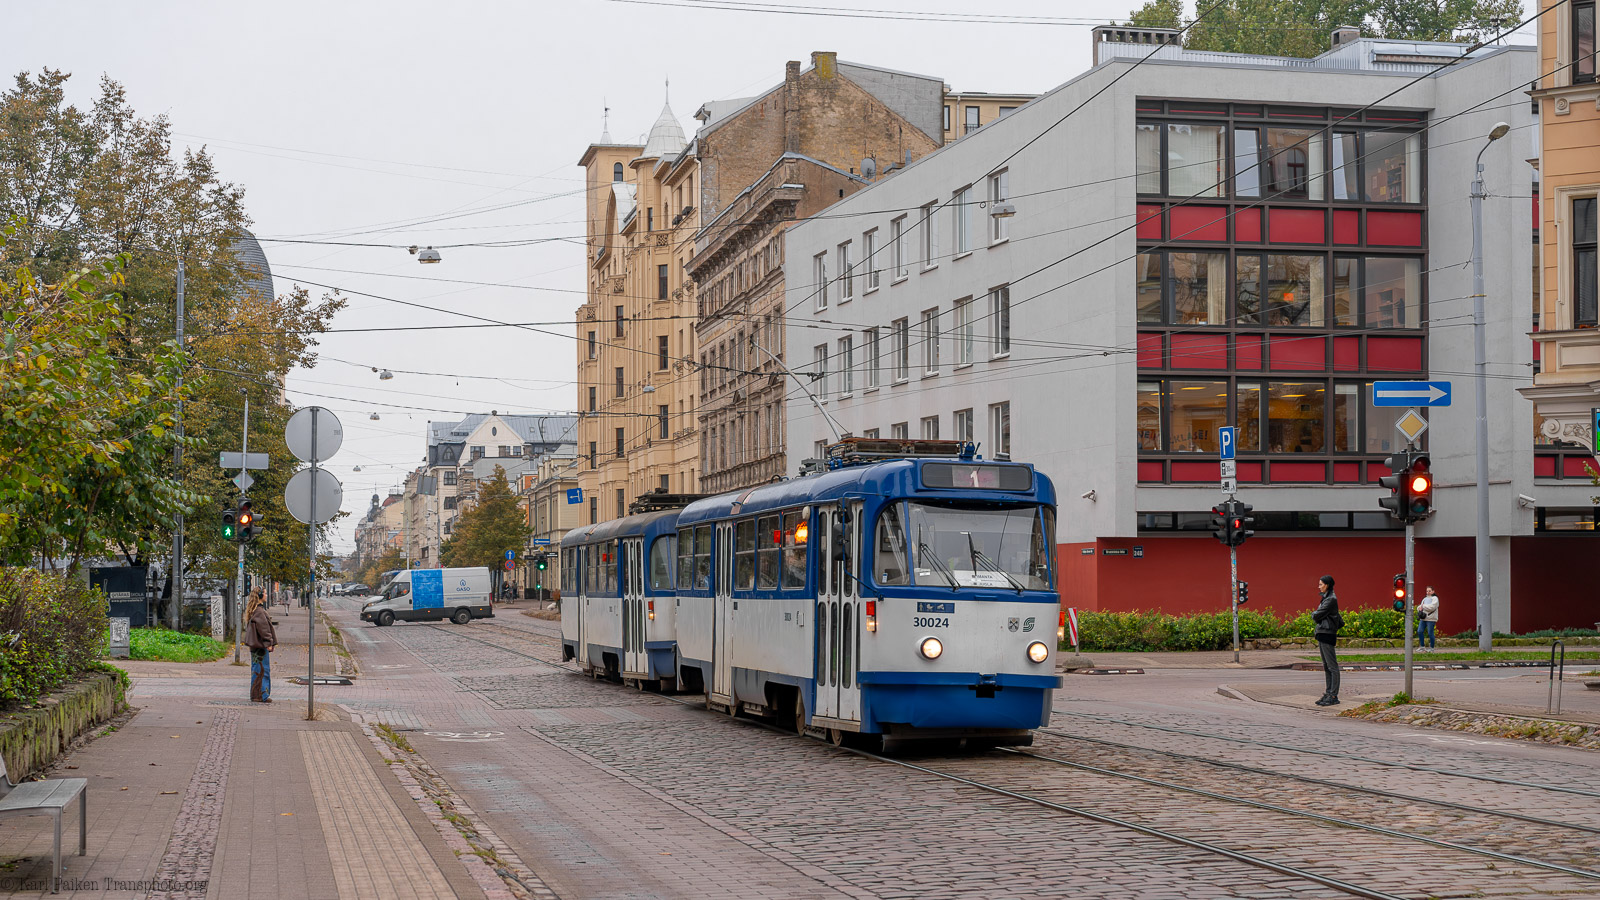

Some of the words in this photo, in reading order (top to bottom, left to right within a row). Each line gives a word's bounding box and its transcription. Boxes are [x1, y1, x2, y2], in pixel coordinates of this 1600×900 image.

[1222, 431, 1231, 456] P
[970, 470, 979, 488] 1
[913, 617, 949, 628] 30024
